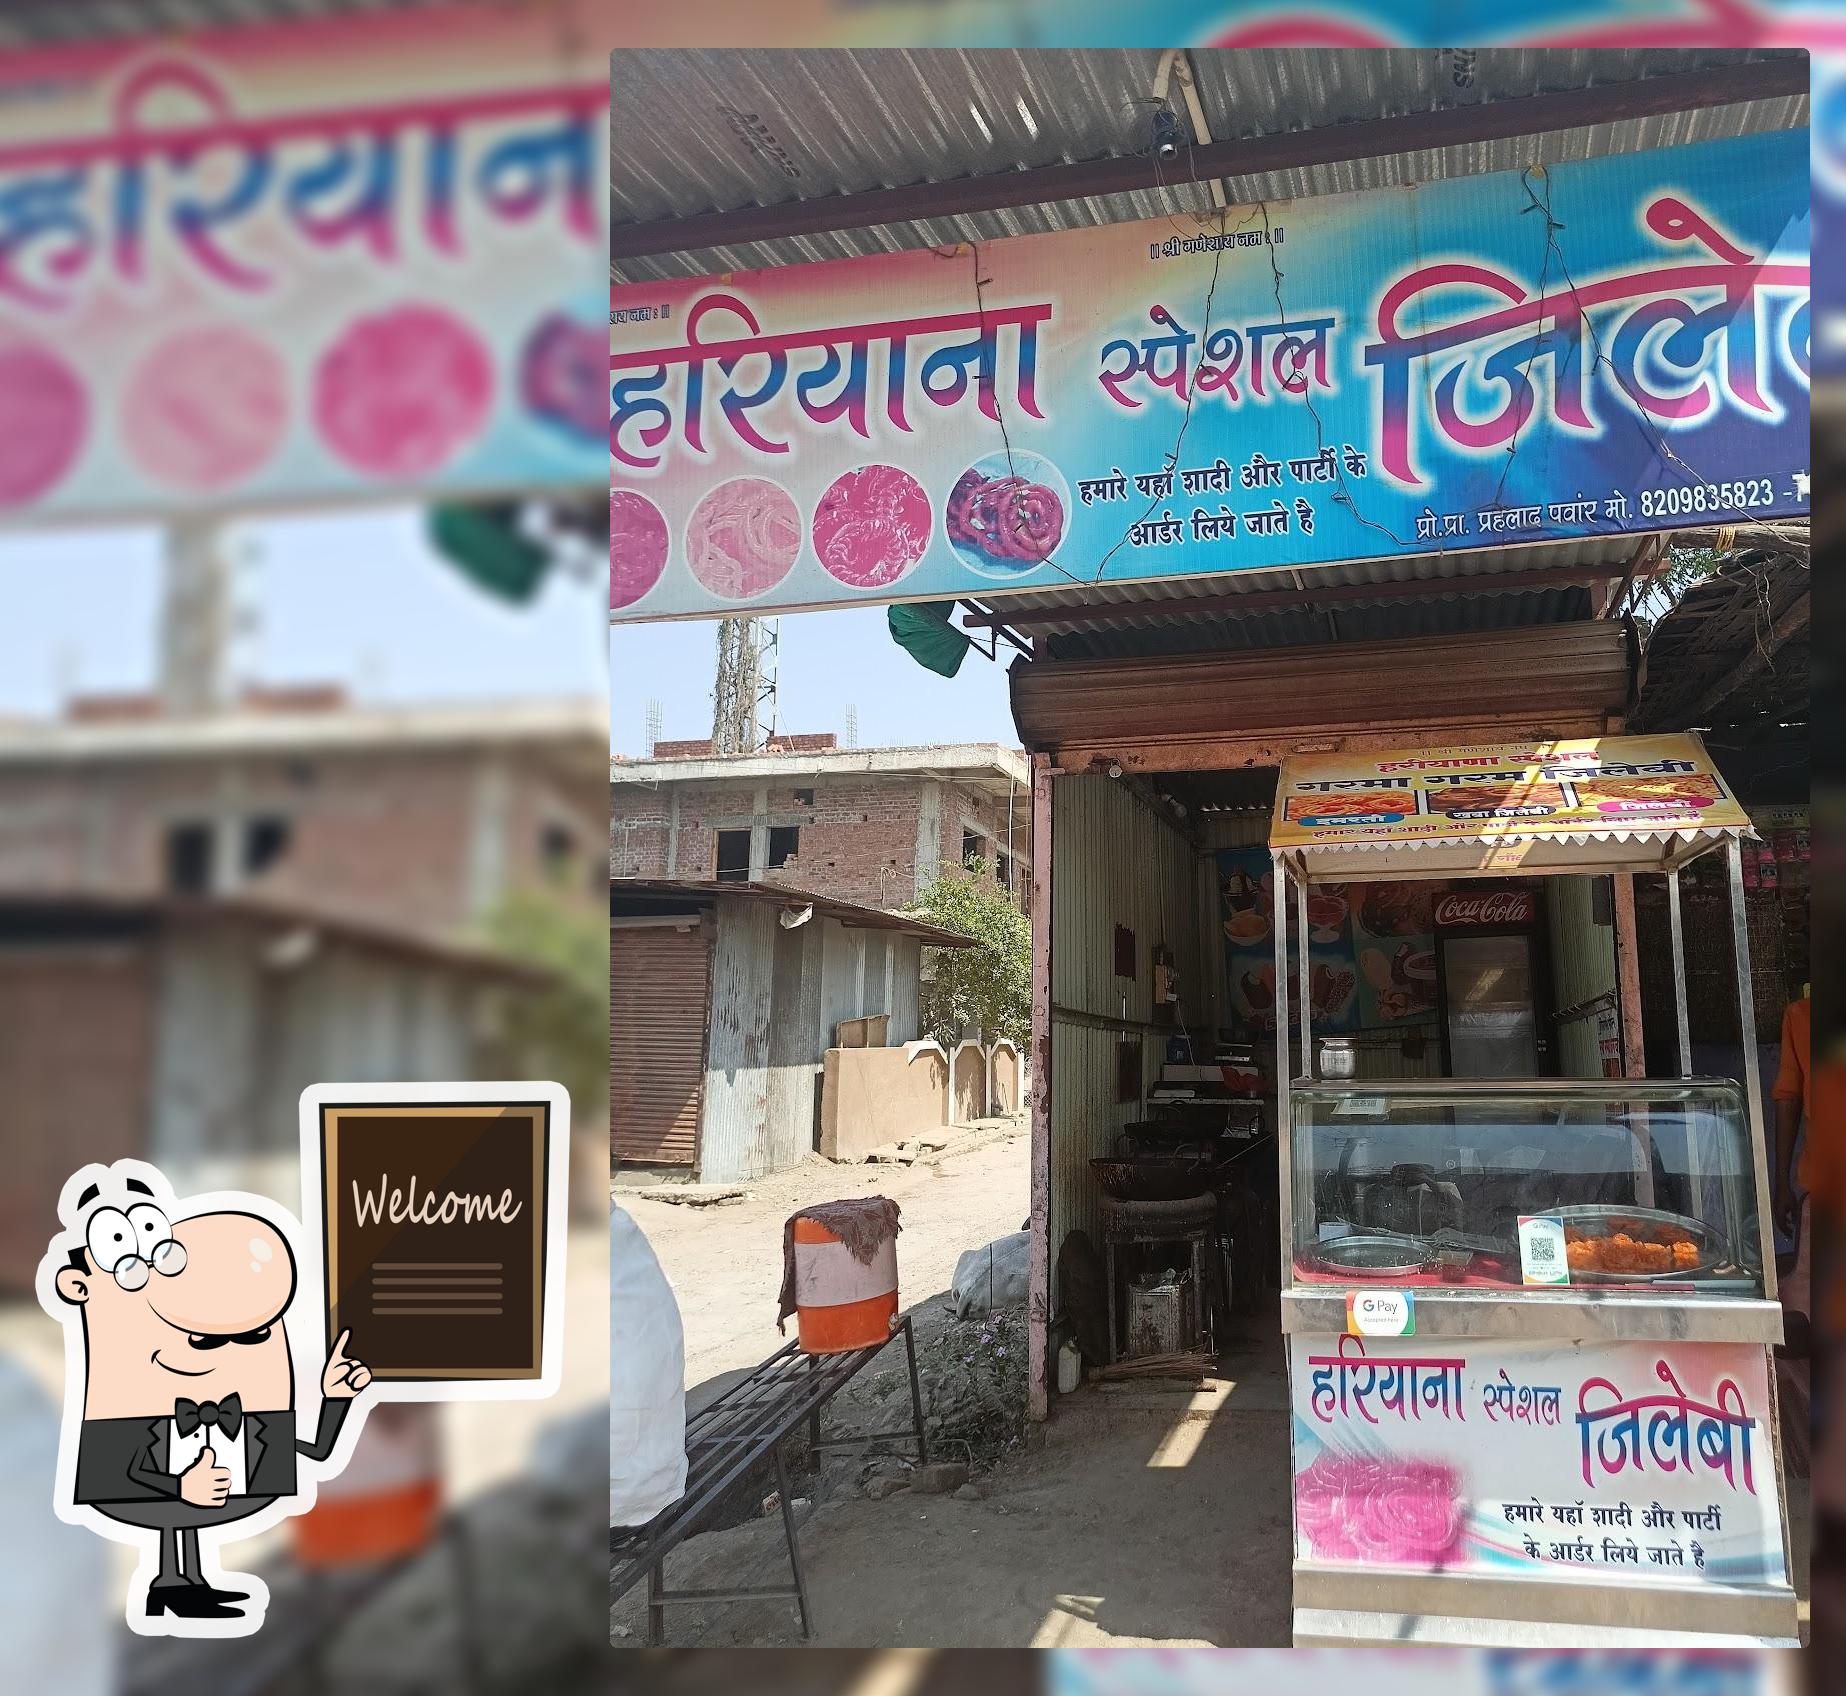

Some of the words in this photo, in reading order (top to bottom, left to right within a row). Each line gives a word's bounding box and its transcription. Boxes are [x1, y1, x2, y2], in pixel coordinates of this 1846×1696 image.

[1162, 236, 1181, 257] श्री
[1183, 233, 1235, 253] गणेशाय
[610, 294, 1053, 468] हरियाना
[1098, 304, 1336, 408] स्पेशल
[1078, 468, 1128, 505] हमारे
[1181, 460, 1231, 494] शादी
[1241, 454, 1282, 487] और
[1289, 447, 1337, 481] पार्टी
[1343, 445, 1366, 478] के
[1129, 510, 1184, 545] आर्डर
[1190, 505, 1237, 540] लिये
[1244, 501, 1290, 535] जाते
[1296, 498, 1315, 534] है
[1478, 505, 1542, 533] प्रहलाद
[1604, 489, 1633, 519] मो.
[1640, 478, 1775, 518] 8209835823
[1296, 777, 1412, 792] गरमा
[1424, 771, 1527, 785] गरम
[1540, 758, 1695, 780] जिलेबी
[1435, 892, 1529, 924] Coca-Cola
[1363, 1299, 1375, 1312] G
[1378, 1299, 1398, 1315] Pay
[1308, 1333, 1466, 1423] हरियाना
[1482, 1368, 1561, 1426] स्पेशल
[1575, 1359, 1757, 1496] जिलेबी
[1502, 1497, 1544, 1525] हमारे
[1590, 1500, 1632, 1529] शादी
[1642, 1500, 1675, 1529] और
[1681, 1504, 1721, 1531] पार्टी
[1523, 1533, 1541, 1560] के
[1550, 1535, 1594, 1562] आर्डर
[1601, 1537, 1639, 1564] लिये
[1646, 1538, 1684, 1566] जाते
[1690, 1540, 1706, 1569] है
